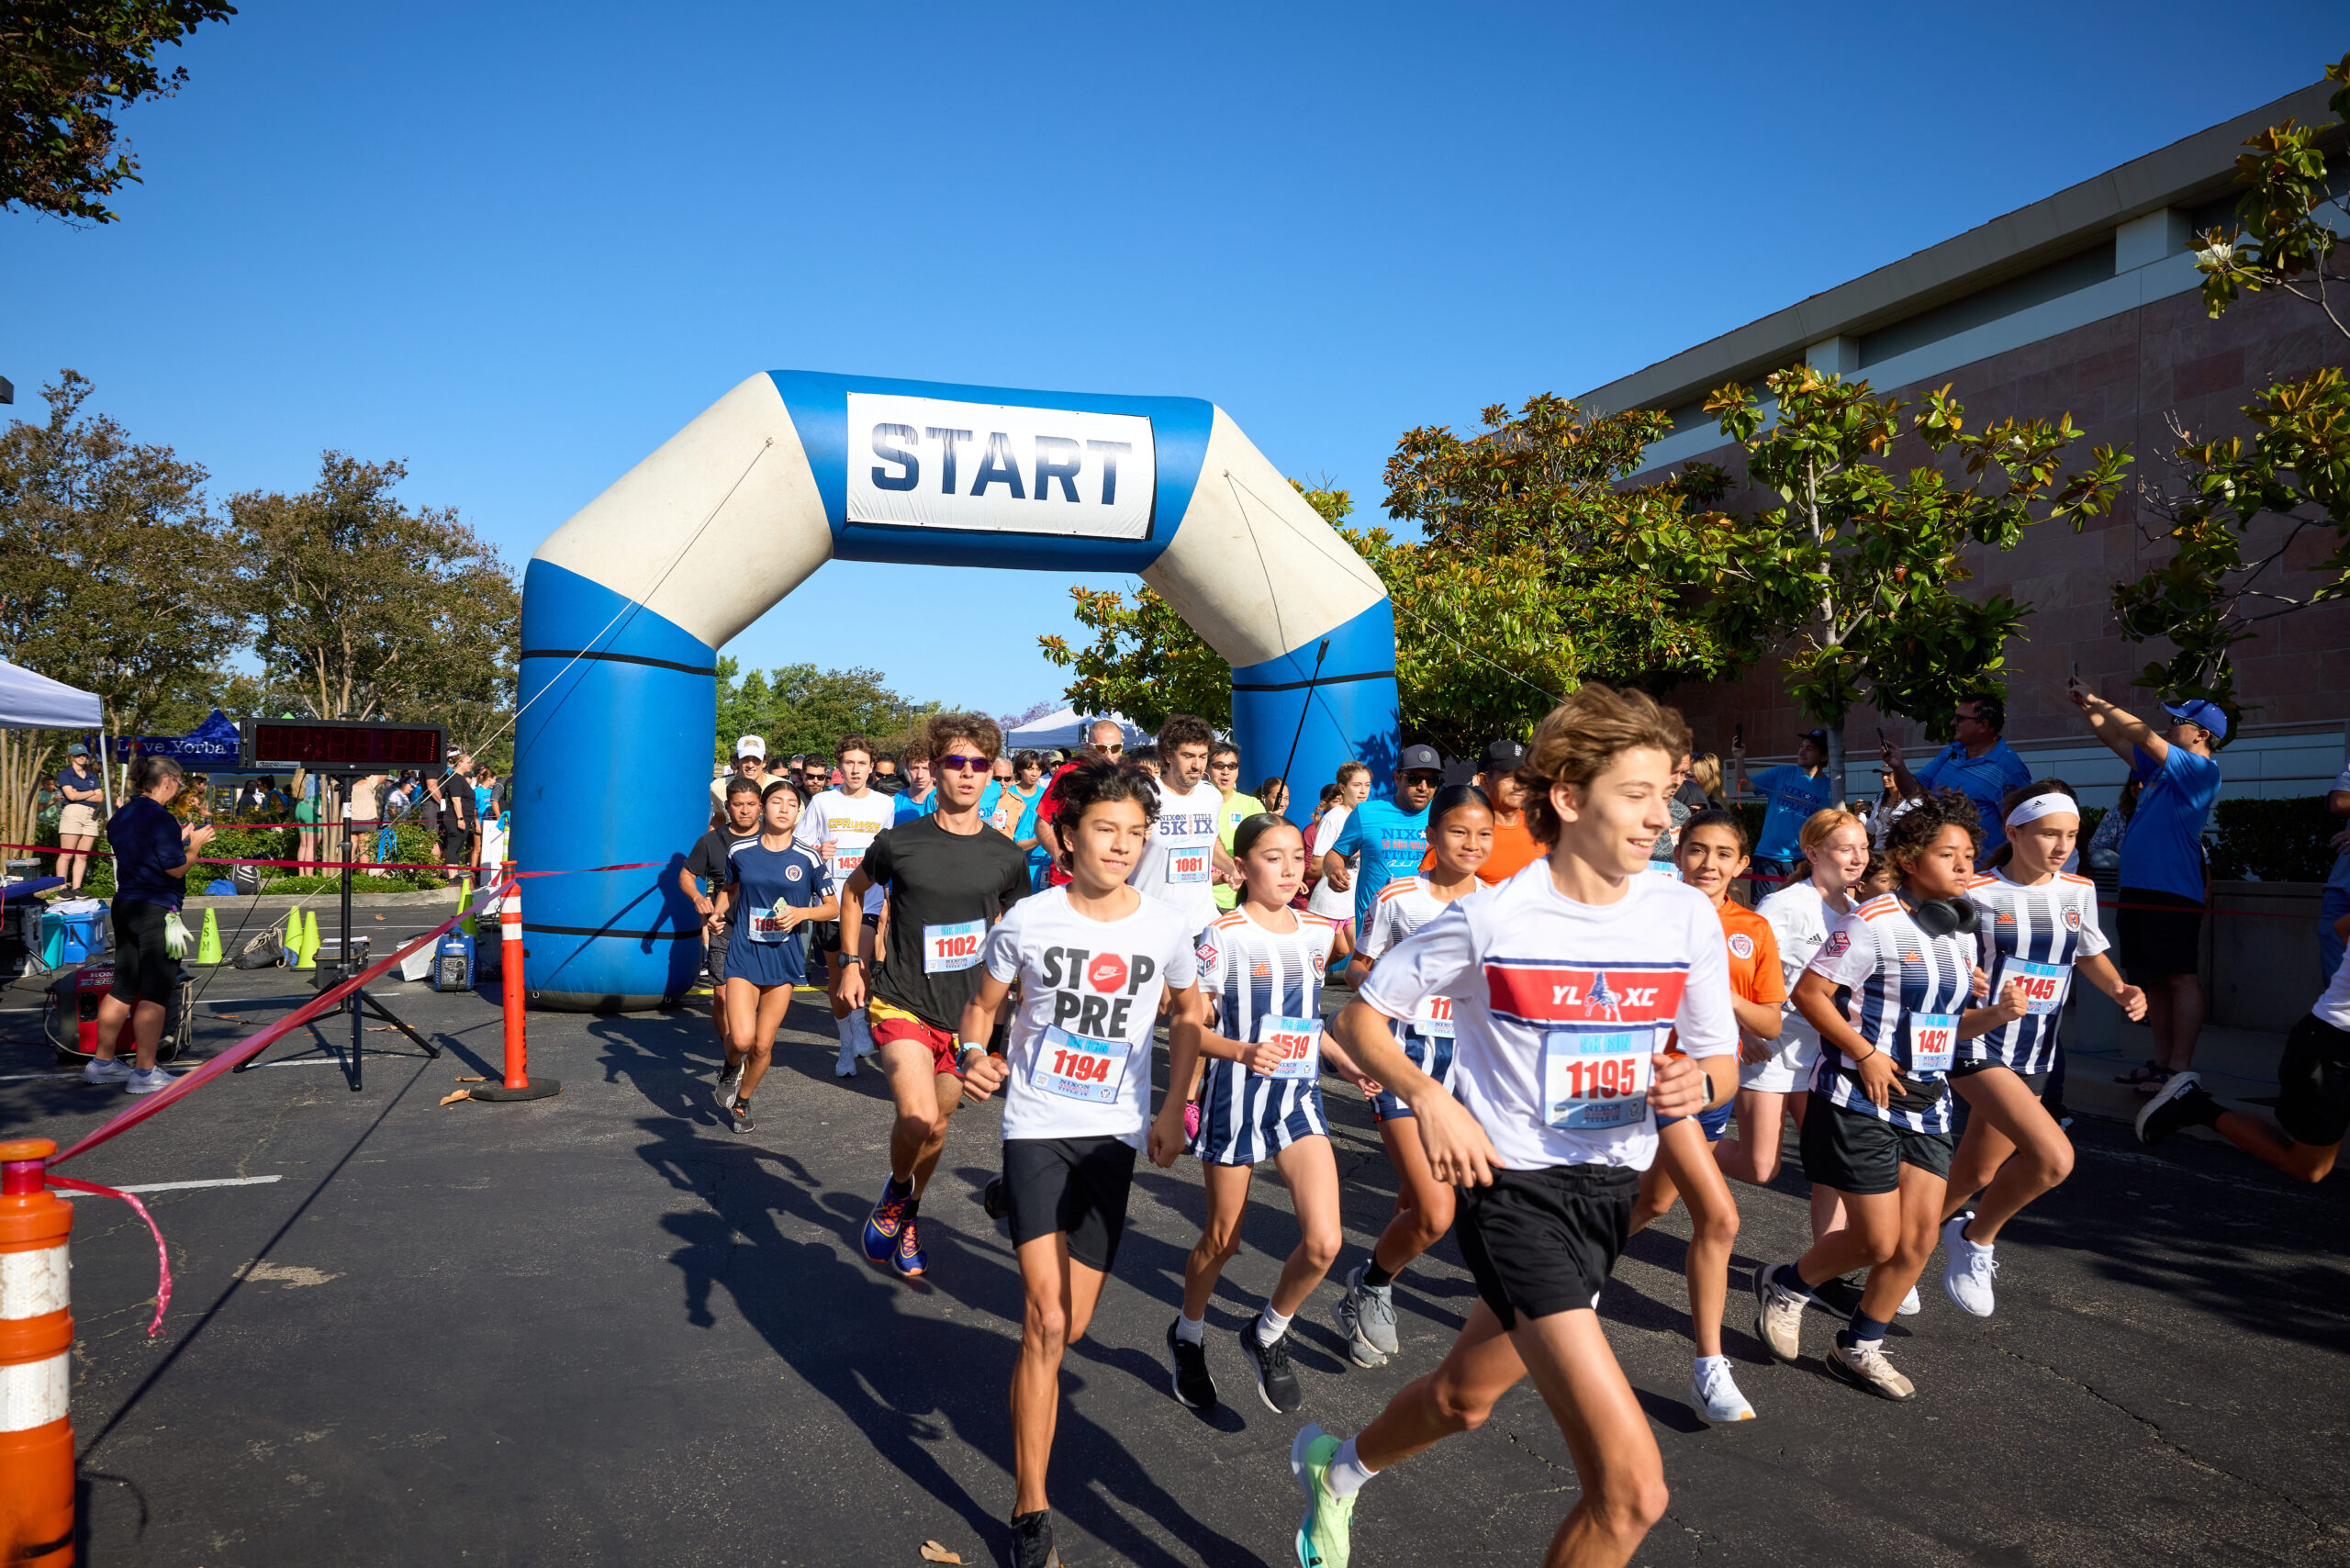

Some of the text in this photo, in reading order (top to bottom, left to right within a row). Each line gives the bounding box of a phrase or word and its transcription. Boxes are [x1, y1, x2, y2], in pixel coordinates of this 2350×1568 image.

[871, 422, 1132, 506] START
[117, 739, 165, 753] Lve
[171, 740, 227, 755] Yorba
[1159, 821, 1188, 835] 5K
[1193, 819, 1214, 834] IX
[1381, 828, 1427, 841] NIXO
[1382, 839, 1391, 849] 5K
[1175, 857, 1203, 872] 1081
[1382, 849, 1425, 861] TITLE
[935, 935, 977, 958] 1102
[1042, 946, 1155, 995] STP
[2024, 962, 2058, 976] 5K RUN
[1552, 985, 1659, 1007] YL XC
[1054, 990, 1133, 1038] PRE
[1430, 997, 1453, 1021] 11
[1067, 1035, 1110, 1054] 5K RUN
[1580, 1034, 1631, 1053] 5K RUN
[1919, 1030, 1949, 1053] 1421
[1053, 1049, 1112, 1082] 1194
[1059, 1079, 1091, 1090] NIXON
[1566, 1058, 1636, 1099] 1195
